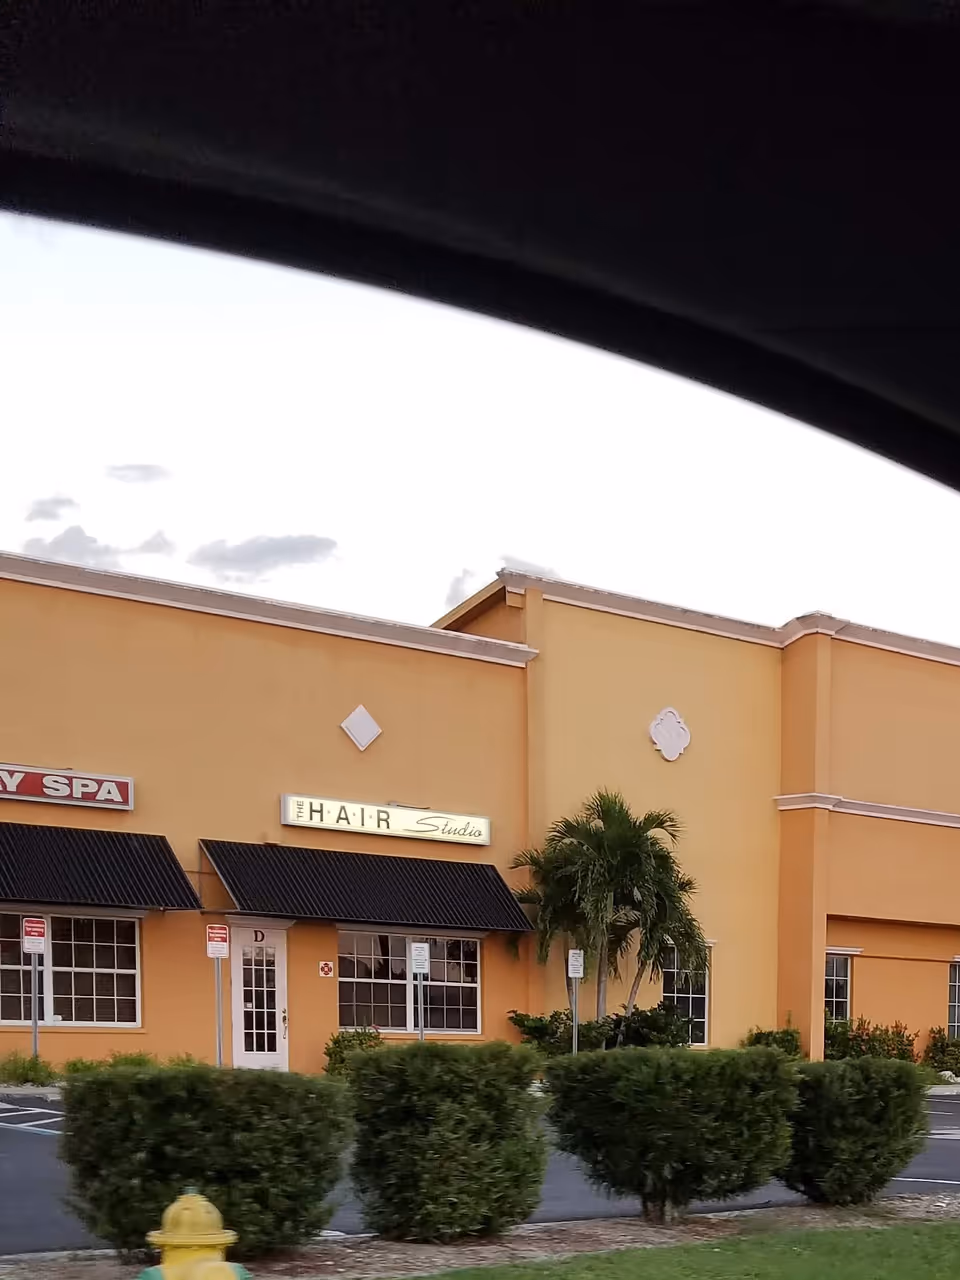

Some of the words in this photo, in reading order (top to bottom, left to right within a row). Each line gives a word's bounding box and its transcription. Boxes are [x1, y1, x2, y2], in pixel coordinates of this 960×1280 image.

[42, 775, 123, 802] SPA
[296, 800, 304, 820] THE
[402, 816, 482, 838] Studio
[253, 929, 265, 942] D
